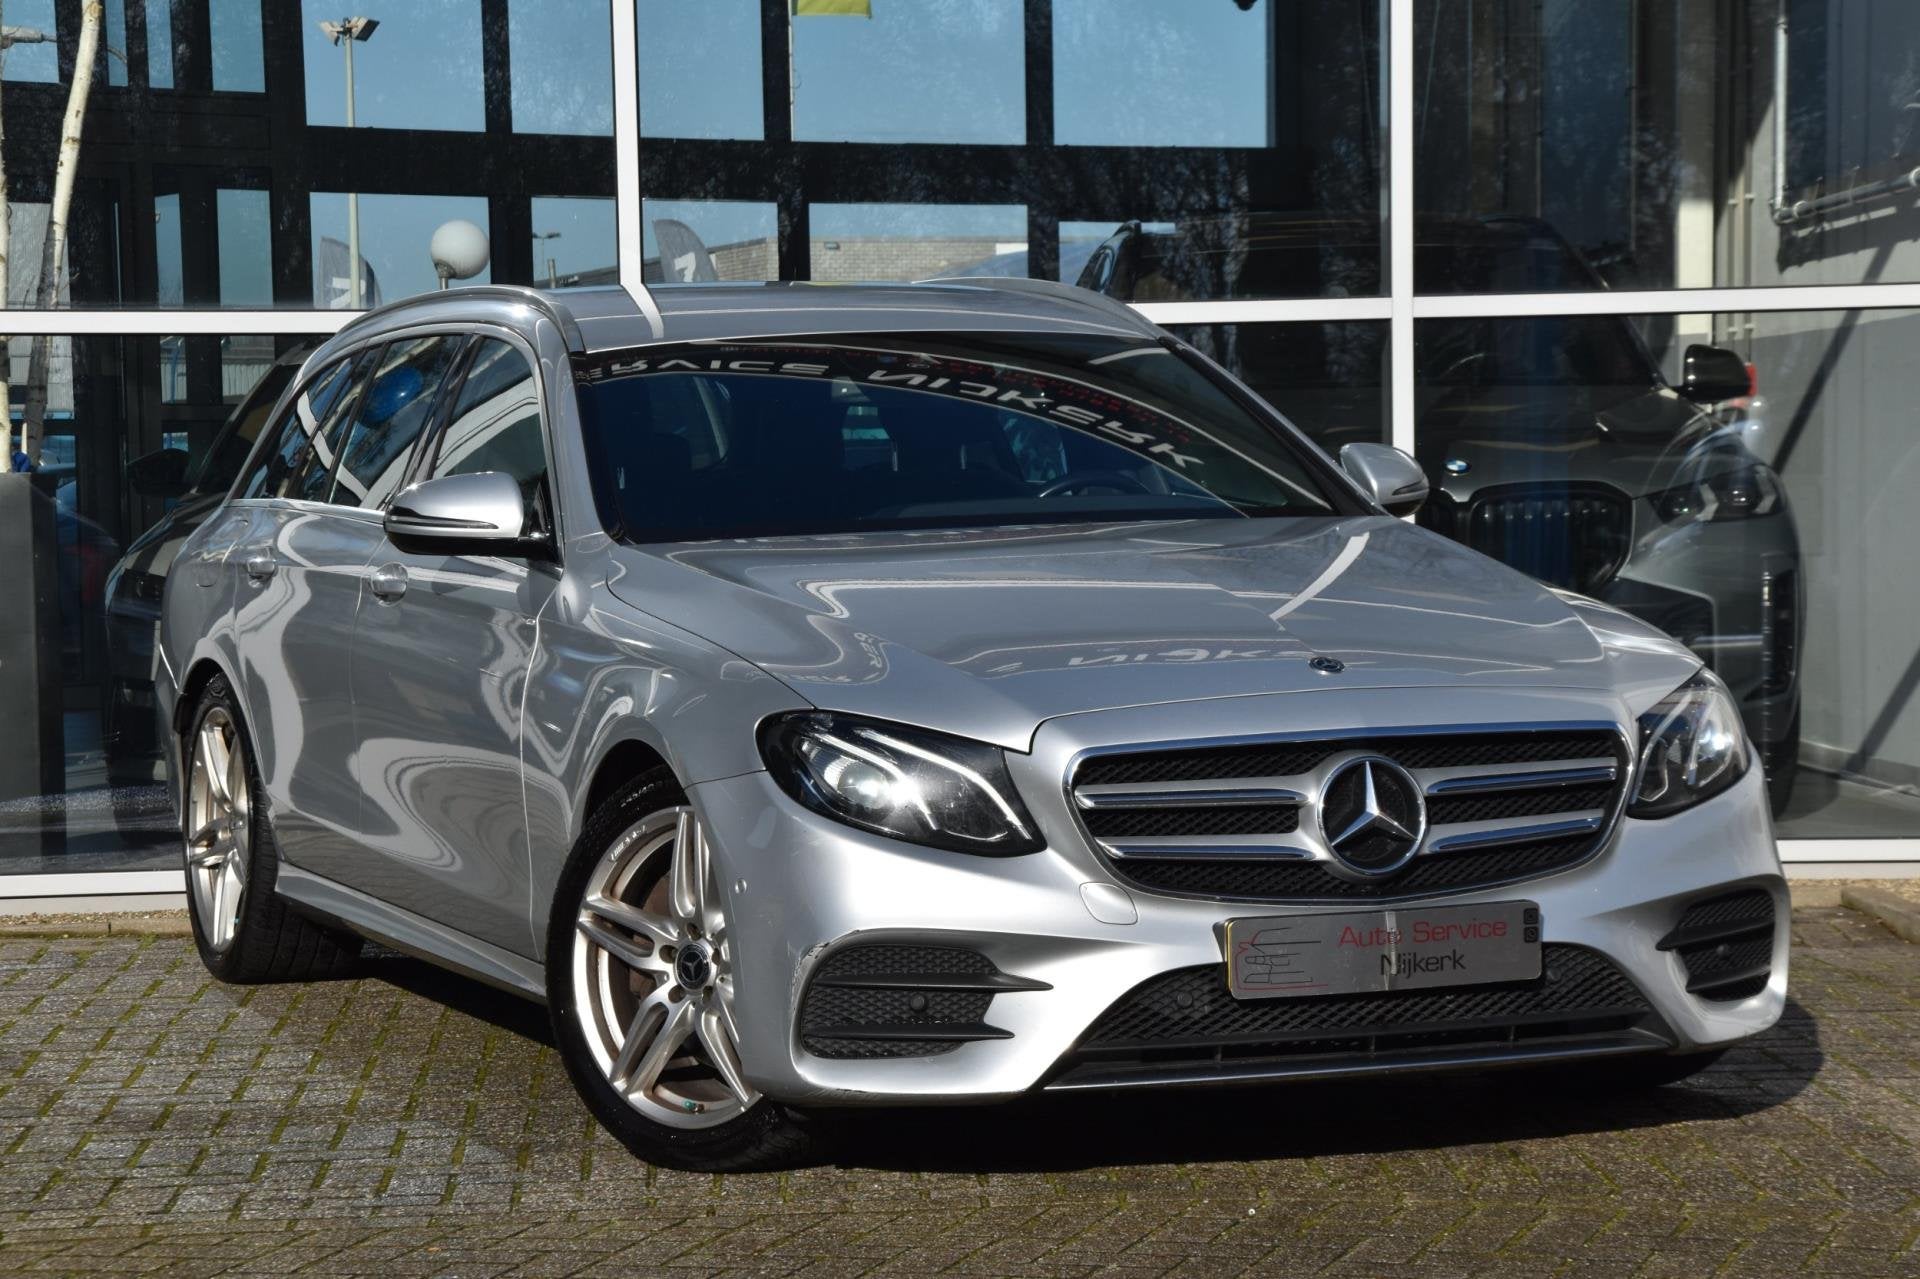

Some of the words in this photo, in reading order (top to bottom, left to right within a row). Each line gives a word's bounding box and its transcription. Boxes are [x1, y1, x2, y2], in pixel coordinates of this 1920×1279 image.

[1338, 926, 1402, 948] Auto
[1412, 919, 1508, 944] Service
[1380, 948, 1467, 980] Nijkerk
